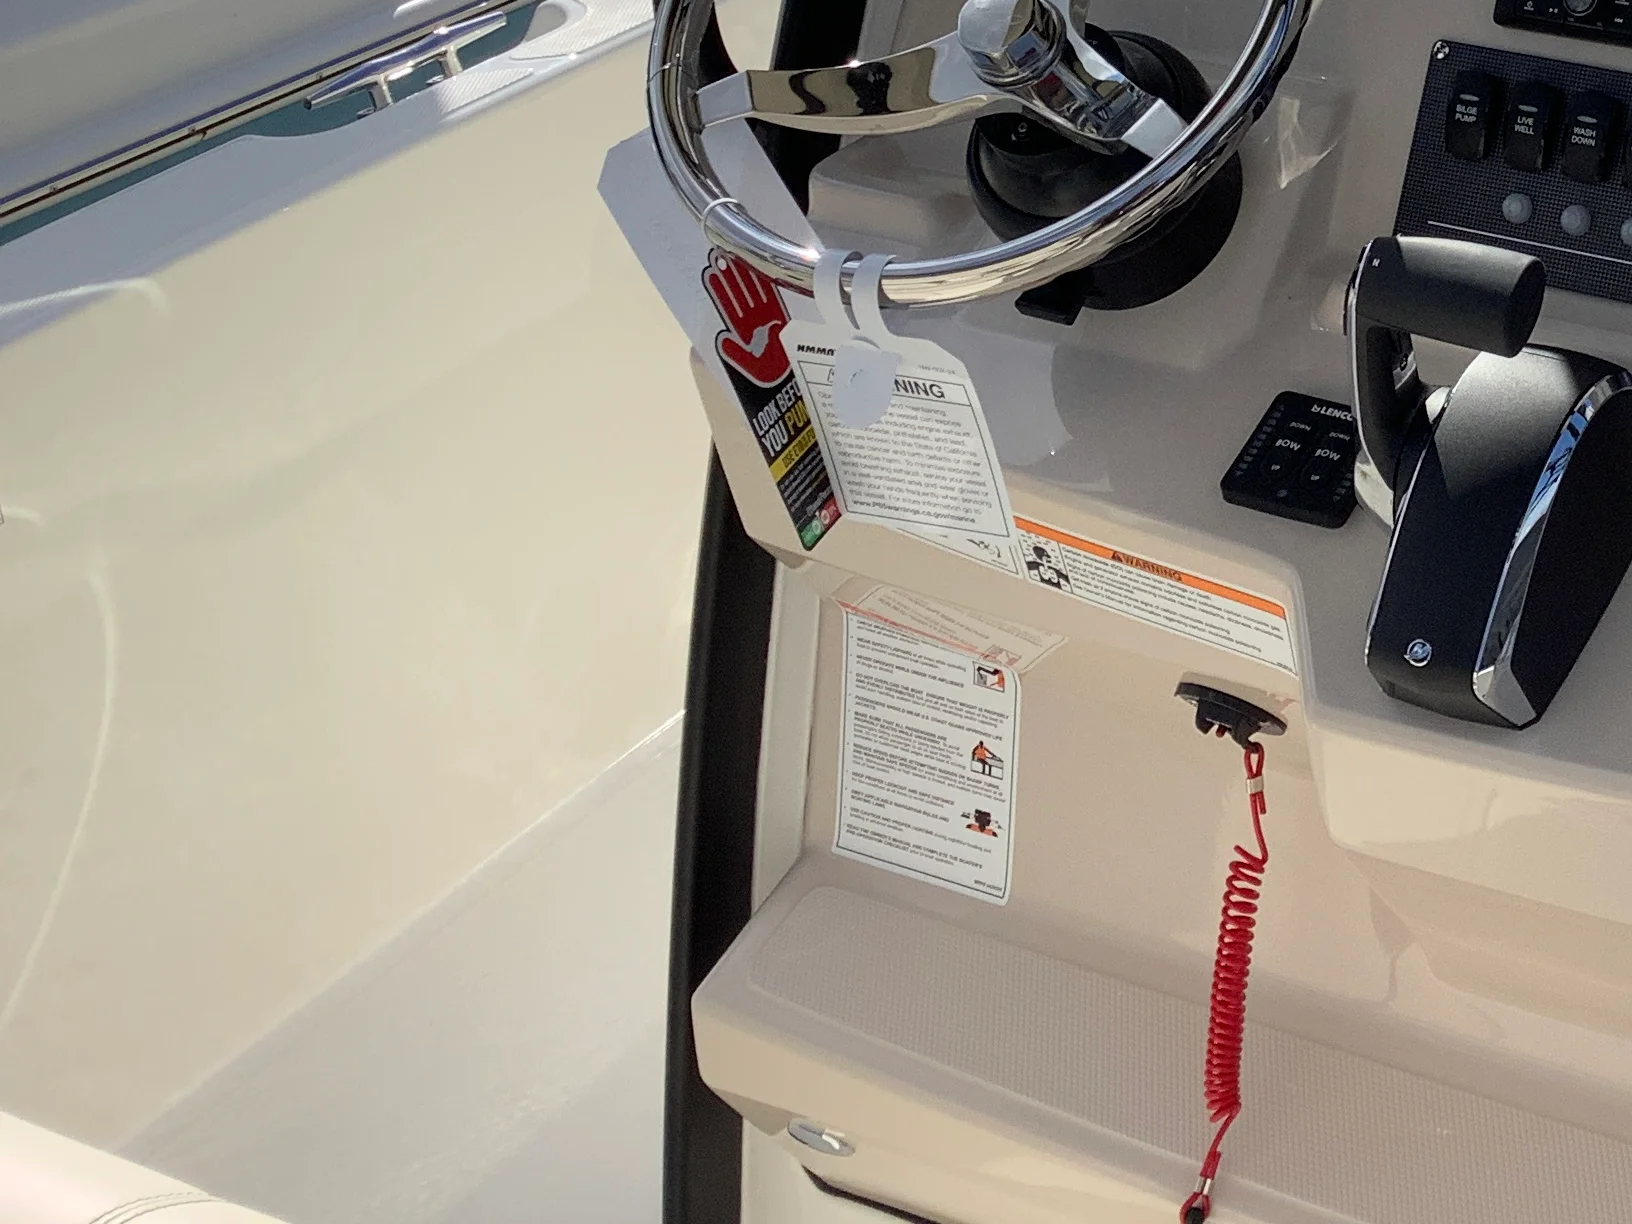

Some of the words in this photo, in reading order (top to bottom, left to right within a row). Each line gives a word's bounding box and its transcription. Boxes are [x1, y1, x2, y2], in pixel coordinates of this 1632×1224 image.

[1456, 103, 1478, 116] BILGE
[1455, 112, 1477, 123] PUMP
[1517, 116, 1534, 126] LIVE
[1514, 124, 1535, 135] WELL
[1573, 126, 1596, 138] WASH
[1571, 135, 1596, 147] DOWN
[752, 400, 782, 436] LOOK
[761, 419, 788, 457] YOU
[1275, 438, 1301, 451] BOW
[1315, 448, 1341, 461] BOW
[1122, 552, 1182, 581] WARNING
